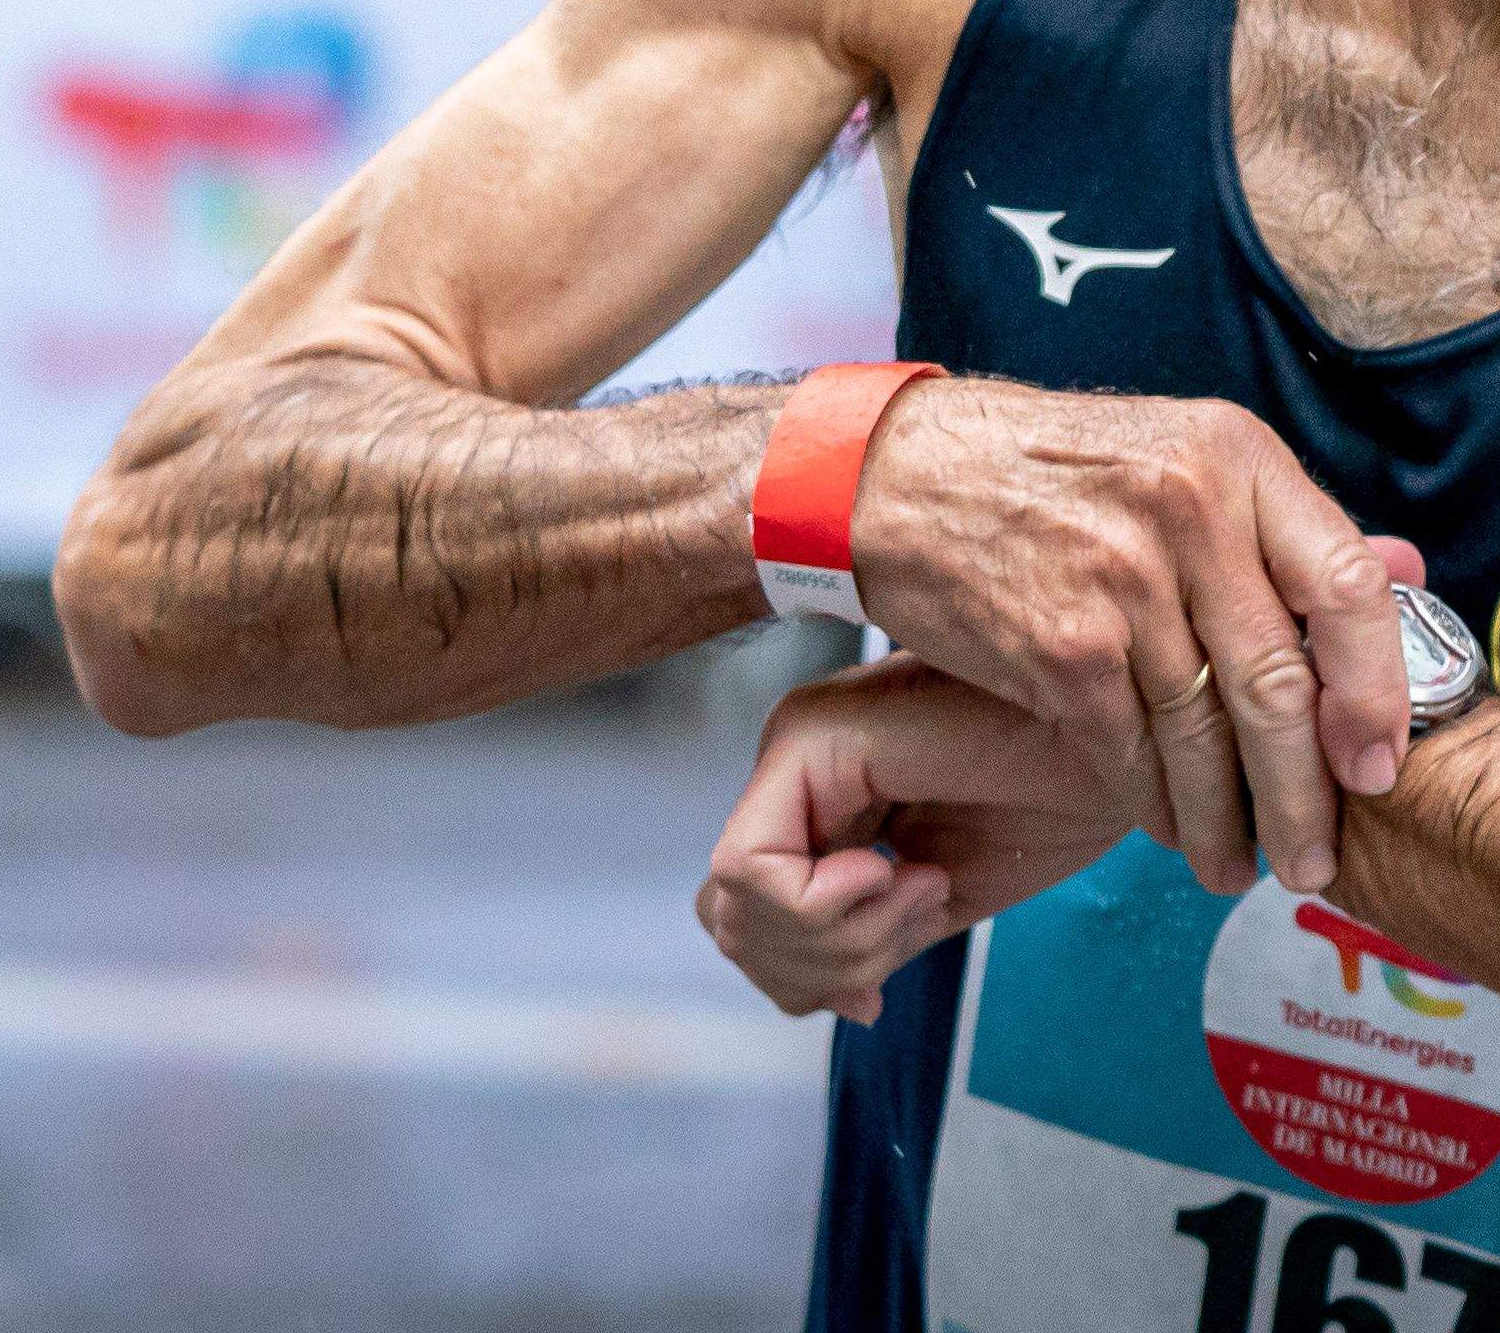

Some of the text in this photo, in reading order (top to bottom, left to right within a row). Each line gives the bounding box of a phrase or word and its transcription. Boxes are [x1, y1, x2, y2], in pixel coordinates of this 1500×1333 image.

[1280, 997, 1476, 1075] TotalEnergies
[1316, 1071, 1410, 1121] MILLA
[1272, 1121, 1438, 1190] DE MADRID
